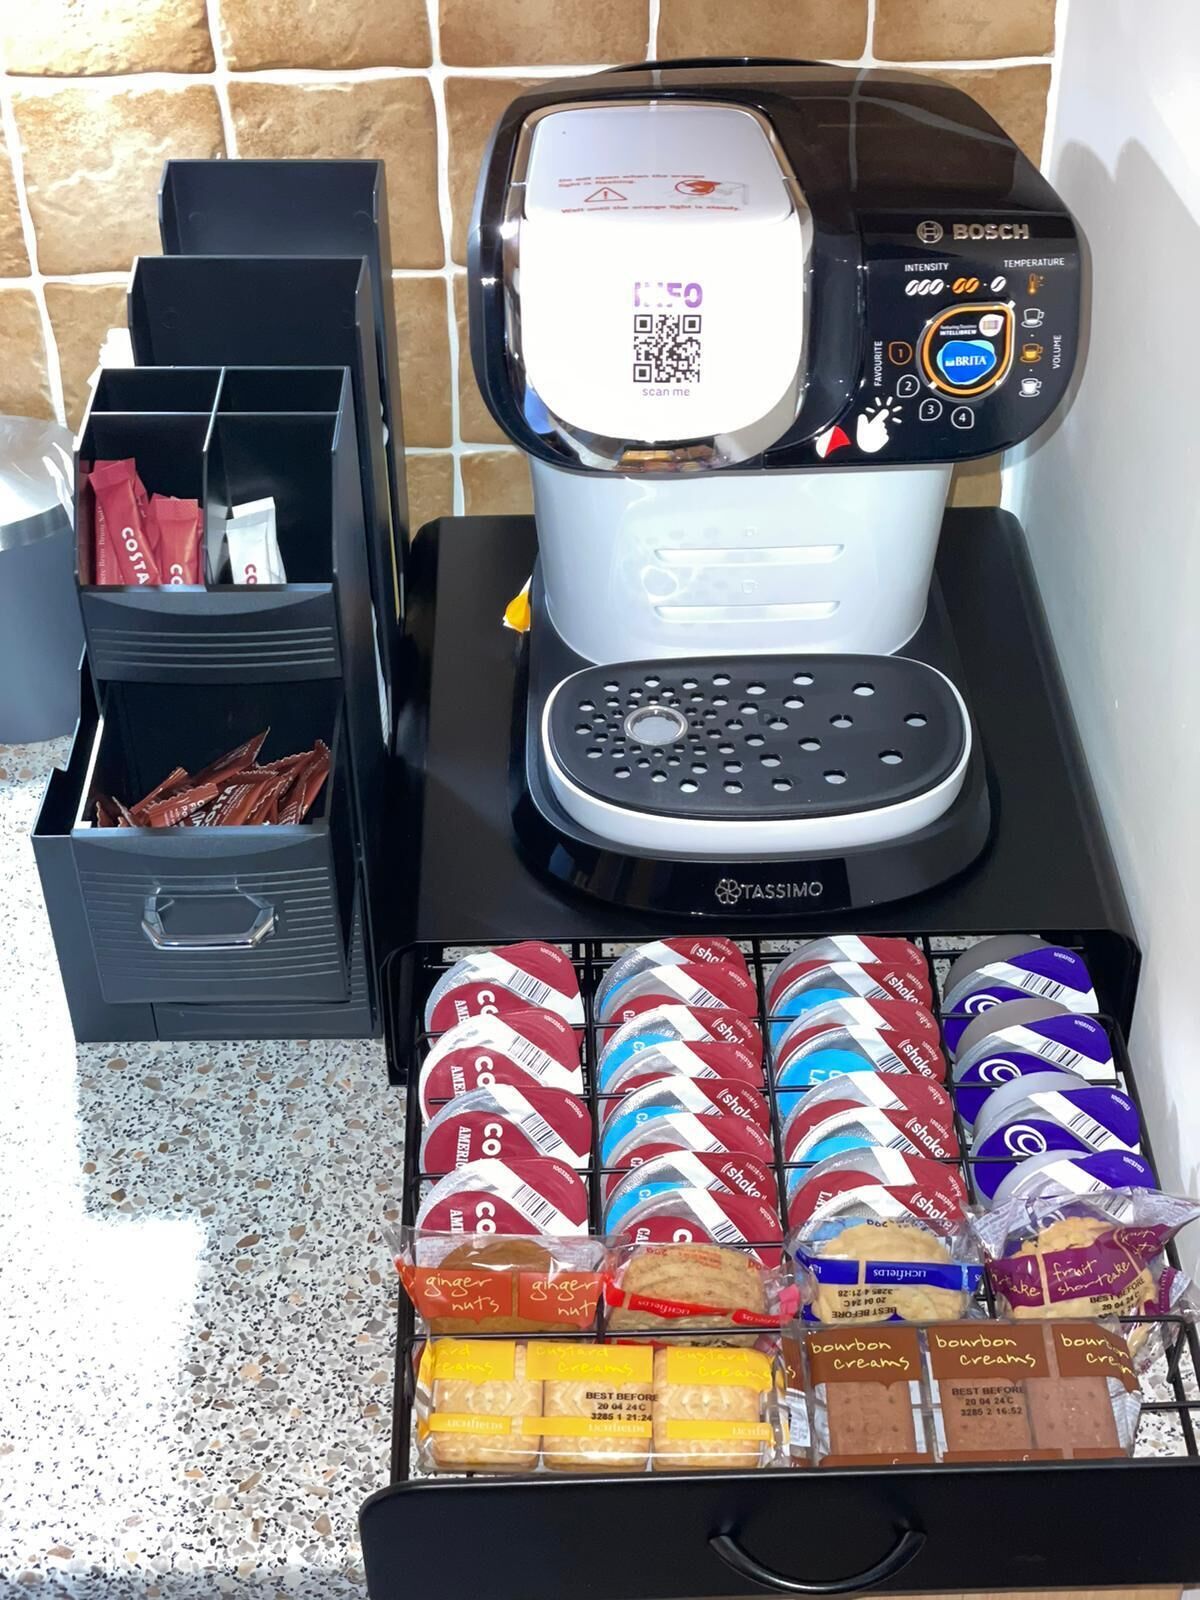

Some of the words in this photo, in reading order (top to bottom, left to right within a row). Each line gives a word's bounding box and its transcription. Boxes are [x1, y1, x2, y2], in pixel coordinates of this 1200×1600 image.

[953, 223, 1030, 240] BOSCH
[904, 262, 949, 272] INTENSITY
[1003, 258, 1065, 268] TEMPERATURE
[1052, 334, 1062, 369] VOLUME
[874, 340, 883, 387] FAVOURITE
[955, 355, 987, 367] BRITA
[642, 388, 670, 397] scan
[672, 388, 690, 397] me
[905, 381, 912, 391] 2
[928, 404, 935, 414] 3
[959, 412, 967, 423] 4
[121, 527, 150, 584] COSTA
[740, 882, 823, 900] TASSIMO
[903, 1043, 932, 1077] shake
[911, 1122, 945, 1158] shake
[1052, 1258, 1098, 1281] fruit
[424, 1273, 493, 1297] ginger
[1057, 1261, 1130, 1295] shortcake
[530, 1275, 599, 1301] ginger
[452, 1296, 500, 1312] nuts
[872, 1306, 897, 1316] BEST
[832, 1309, 870, 1319] BEFORE
[811, 1337, 892, 1354] bourbon
[935, 1334, 1017, 1348] bourbon
[833, 1356, 910, 1371] creams
[959, 1352, 1036, 1367] creams
[585, 1391, 614, 1400] BEST
[616, 1391, 658, 1402] BEFORE
[952, 1387, 979, 1396] BEST
[982, 1386, 1026, 1395] BEFORE
[597, 1402, 609, 1411] 20
[611, 1403, 623, 1411] 04
[626, 1403, 638, 1411] 24
[638, 1403, 646, 1411] C
[965, 1398, 976, 1406] 20
[979, 1398, 991, 1406] 04
[994, 1397, 1006, 1405] 24
[1006, 1396, 1014, 1404] C
[591, 1413, 614, 1421] 3285
[626, 1413, 653, 1421] 21:24
